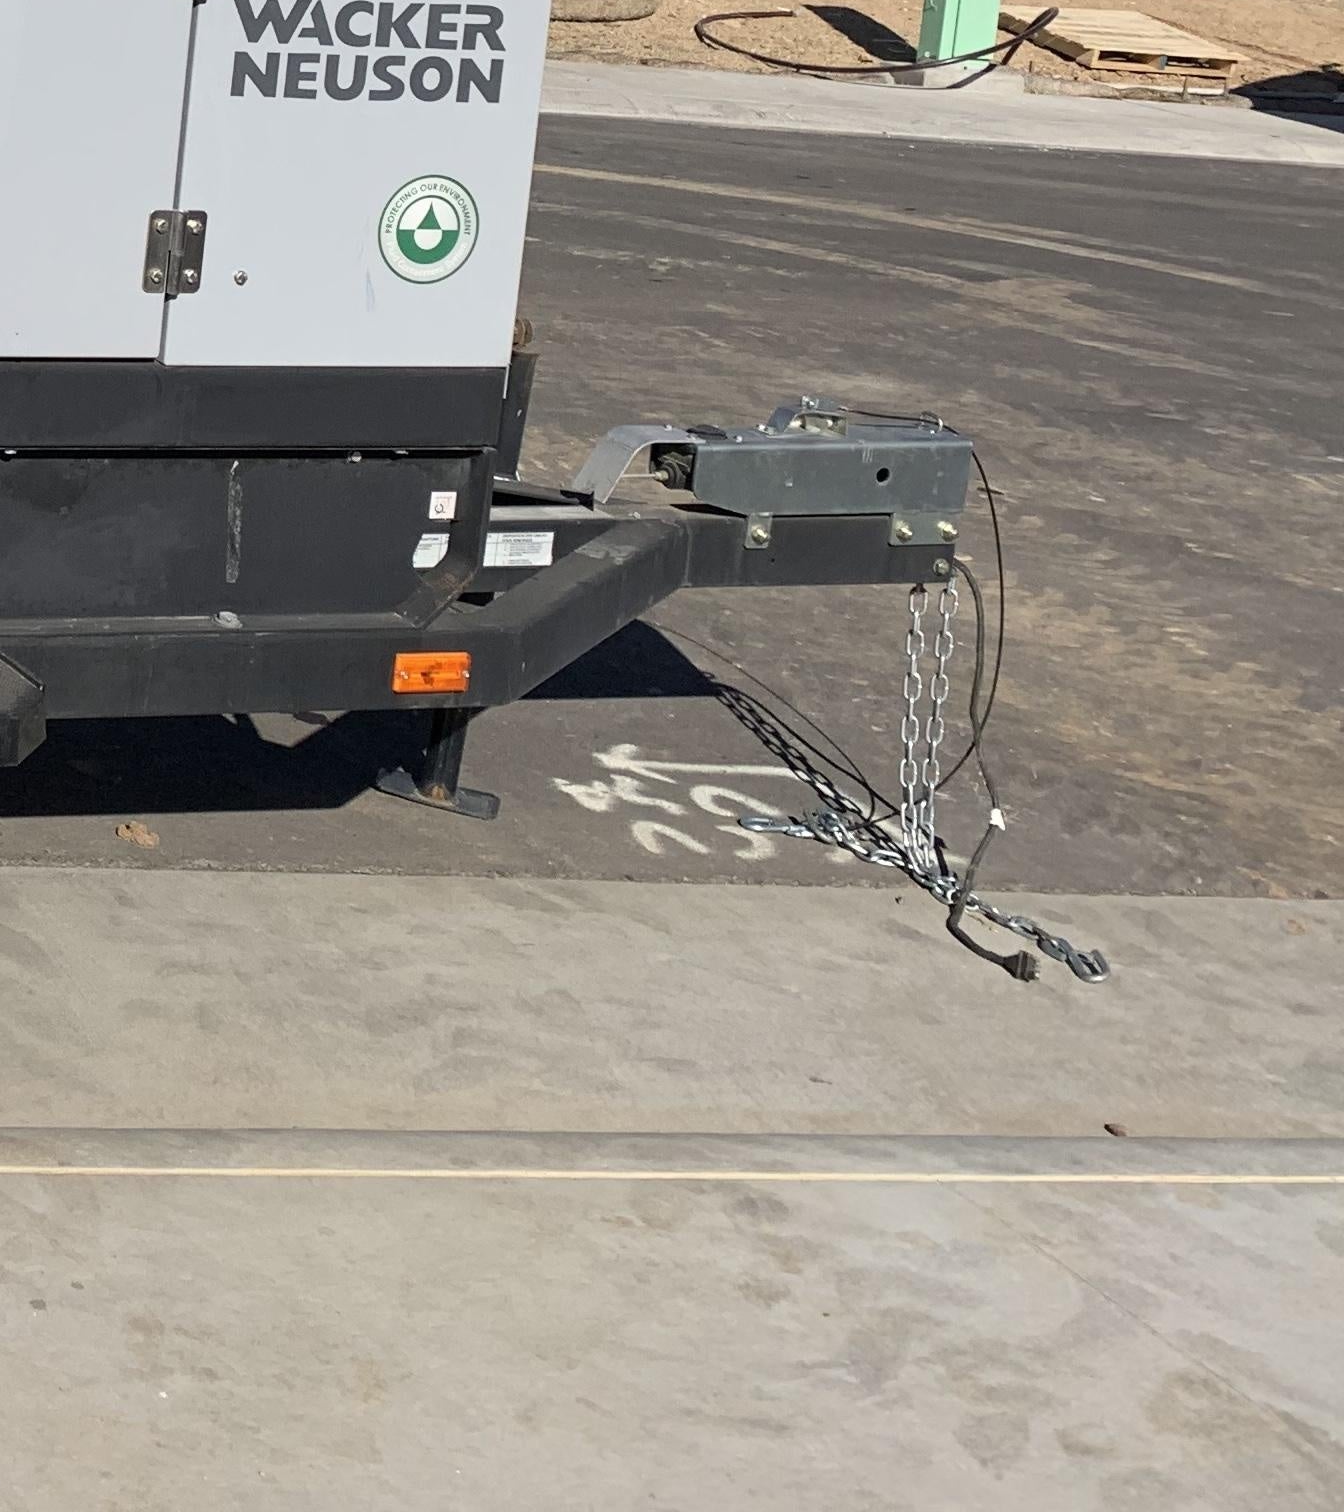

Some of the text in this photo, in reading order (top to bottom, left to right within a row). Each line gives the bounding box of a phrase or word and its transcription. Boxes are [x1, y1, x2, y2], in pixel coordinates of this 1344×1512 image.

[230, 51, 505, 104] NEUSON
[385, 182, 472, 236] PROTECTING OUR ENVIRONMENT
